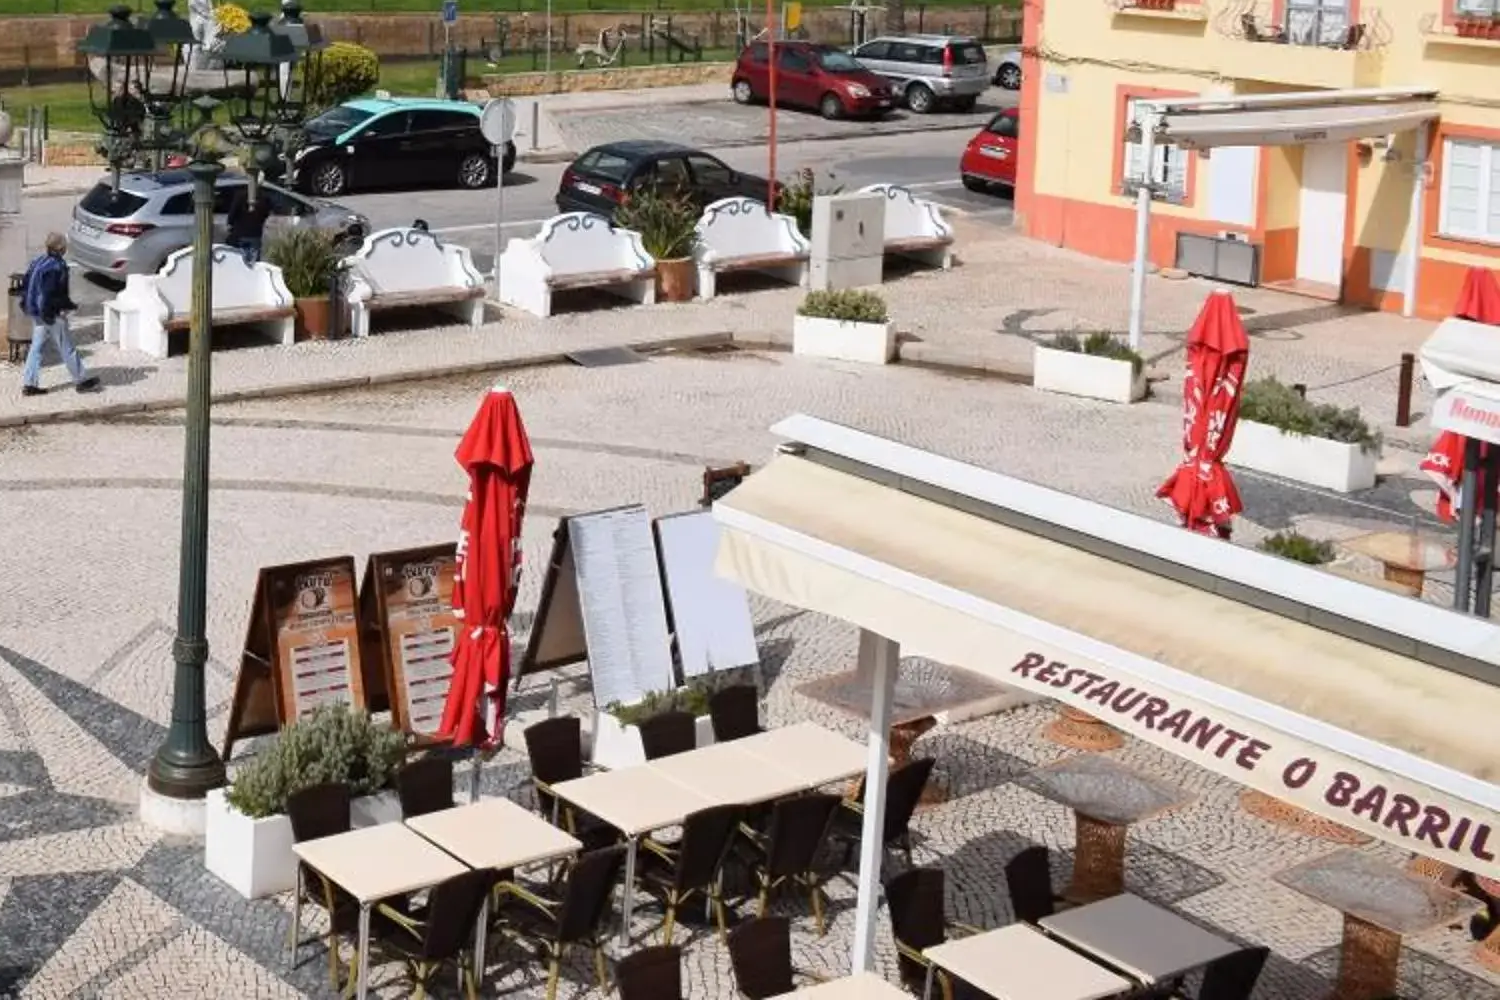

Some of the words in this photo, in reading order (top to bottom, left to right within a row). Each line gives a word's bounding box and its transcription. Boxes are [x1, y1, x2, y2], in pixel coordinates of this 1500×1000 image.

[1011, 652, 1271, 771] RESTAURANTE
[1282, 757, 1317, 789] O
[1324, 771, 1496, 863] BARRIL
